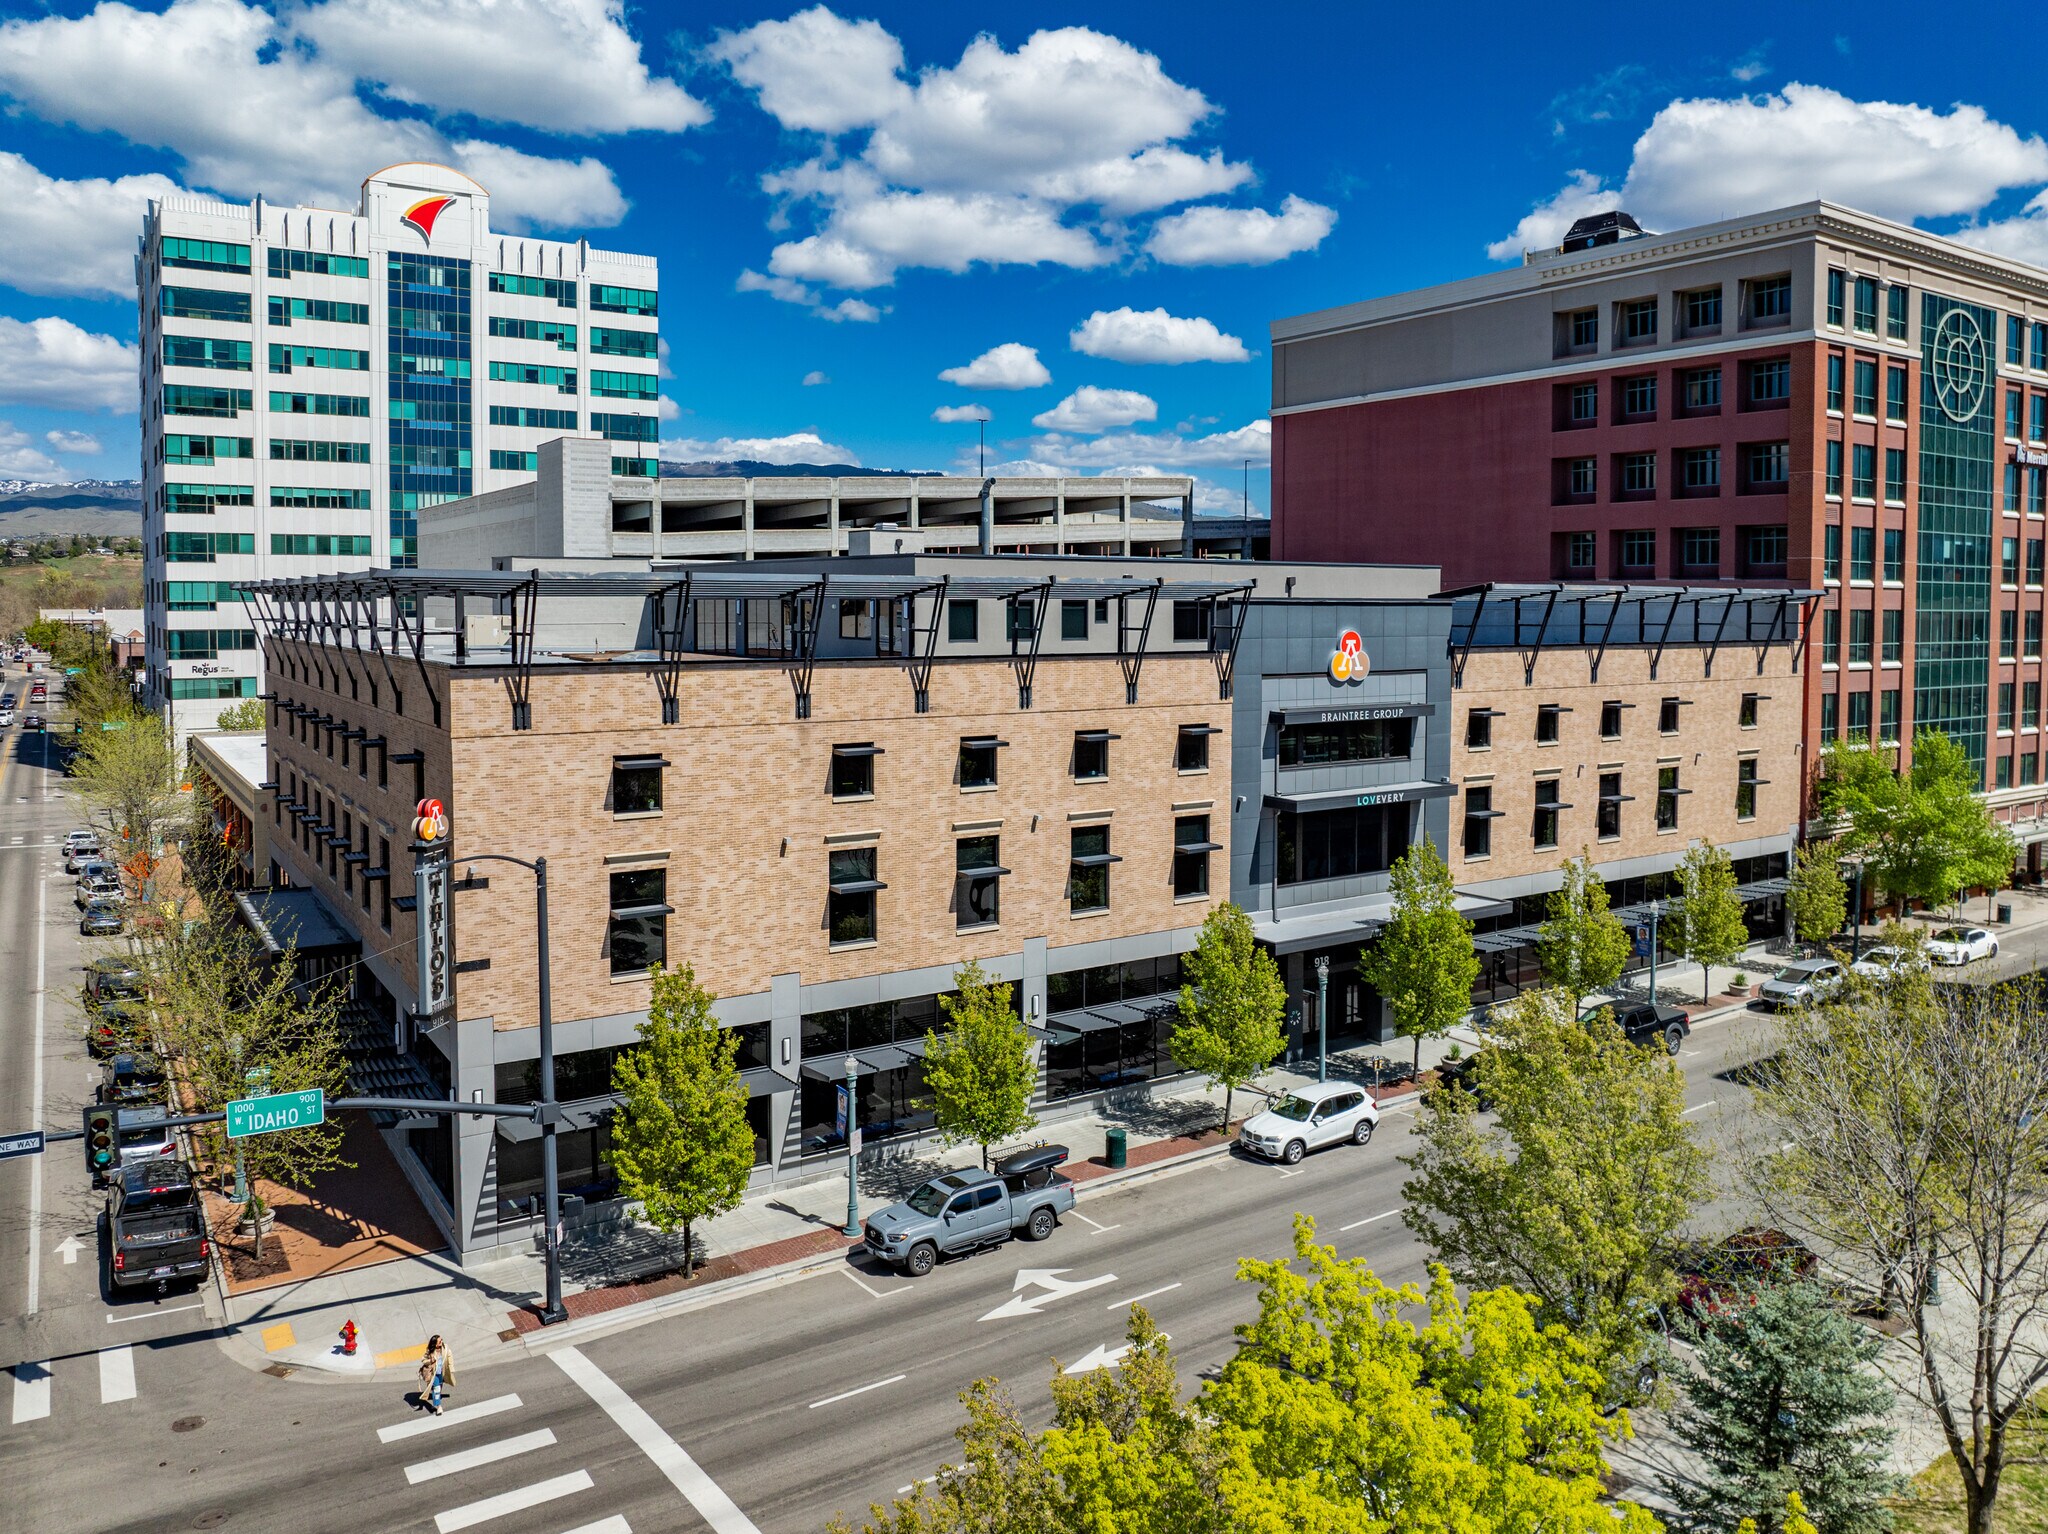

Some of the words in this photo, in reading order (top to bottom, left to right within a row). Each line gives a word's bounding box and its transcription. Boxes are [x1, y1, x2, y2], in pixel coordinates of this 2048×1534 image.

[191, 665, 218, 677] Regus
[1321, 710, 1370, 722] BRAINTREE
[1373, 708, 1404, 719] GROUP
[1358, 792, 1404, 806] LOVEVERY
[1314, 956, 1329, 968] 918
[235, 1103, 254, 1113] 1000
[300, 1094, 316, 1104] 900
[235, 1117, 244, 1126] W.
[248, 1107, 299, 1131] IDAHO
[306, 1106, 316, 1114] ST
[0, 1143, 12, 1151] NE
[16, 1139, 37, 1149] WAY
